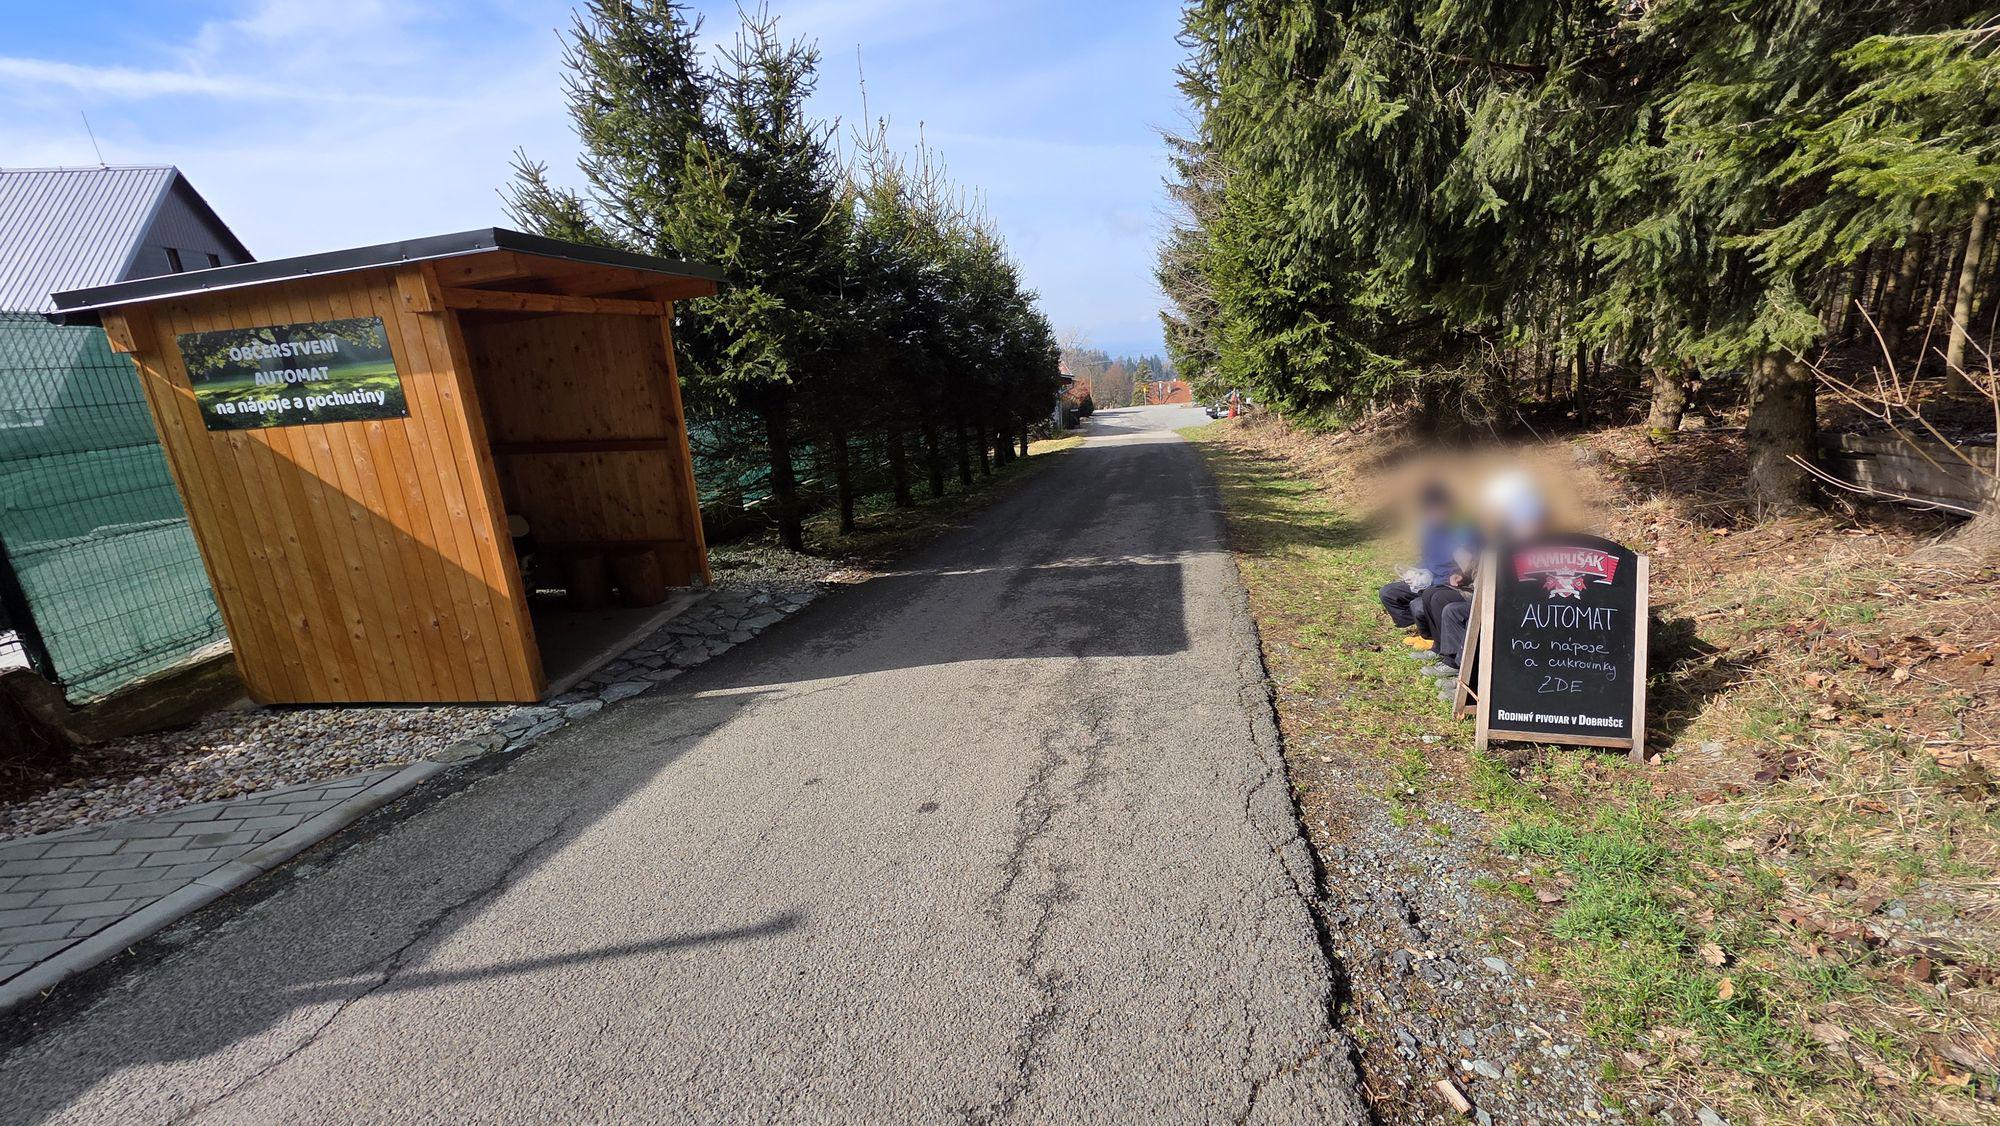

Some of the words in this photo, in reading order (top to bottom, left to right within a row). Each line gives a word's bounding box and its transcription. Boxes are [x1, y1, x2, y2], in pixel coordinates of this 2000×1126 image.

[229, 334, 339, 362] OBČERSTVENÍ
[254, 367, 329, 386] AUTOMAT
[216, 400, 236, 415] na
[238, 395, 291, 414] nápoje
[293, 396, 304, 409] a
[306, 388, 385, 411] pochutiny
[1520, 603, 1618, 631] AUTOMAT
[1511, 638, 1540, 650] na
[1550, 636, 1609, 654] nápoje
[1524, 657, 1538, 667] a
[1548, 657, 1617, 681] cukrovinky
[1537, 675, 1584, 694] ZDE
